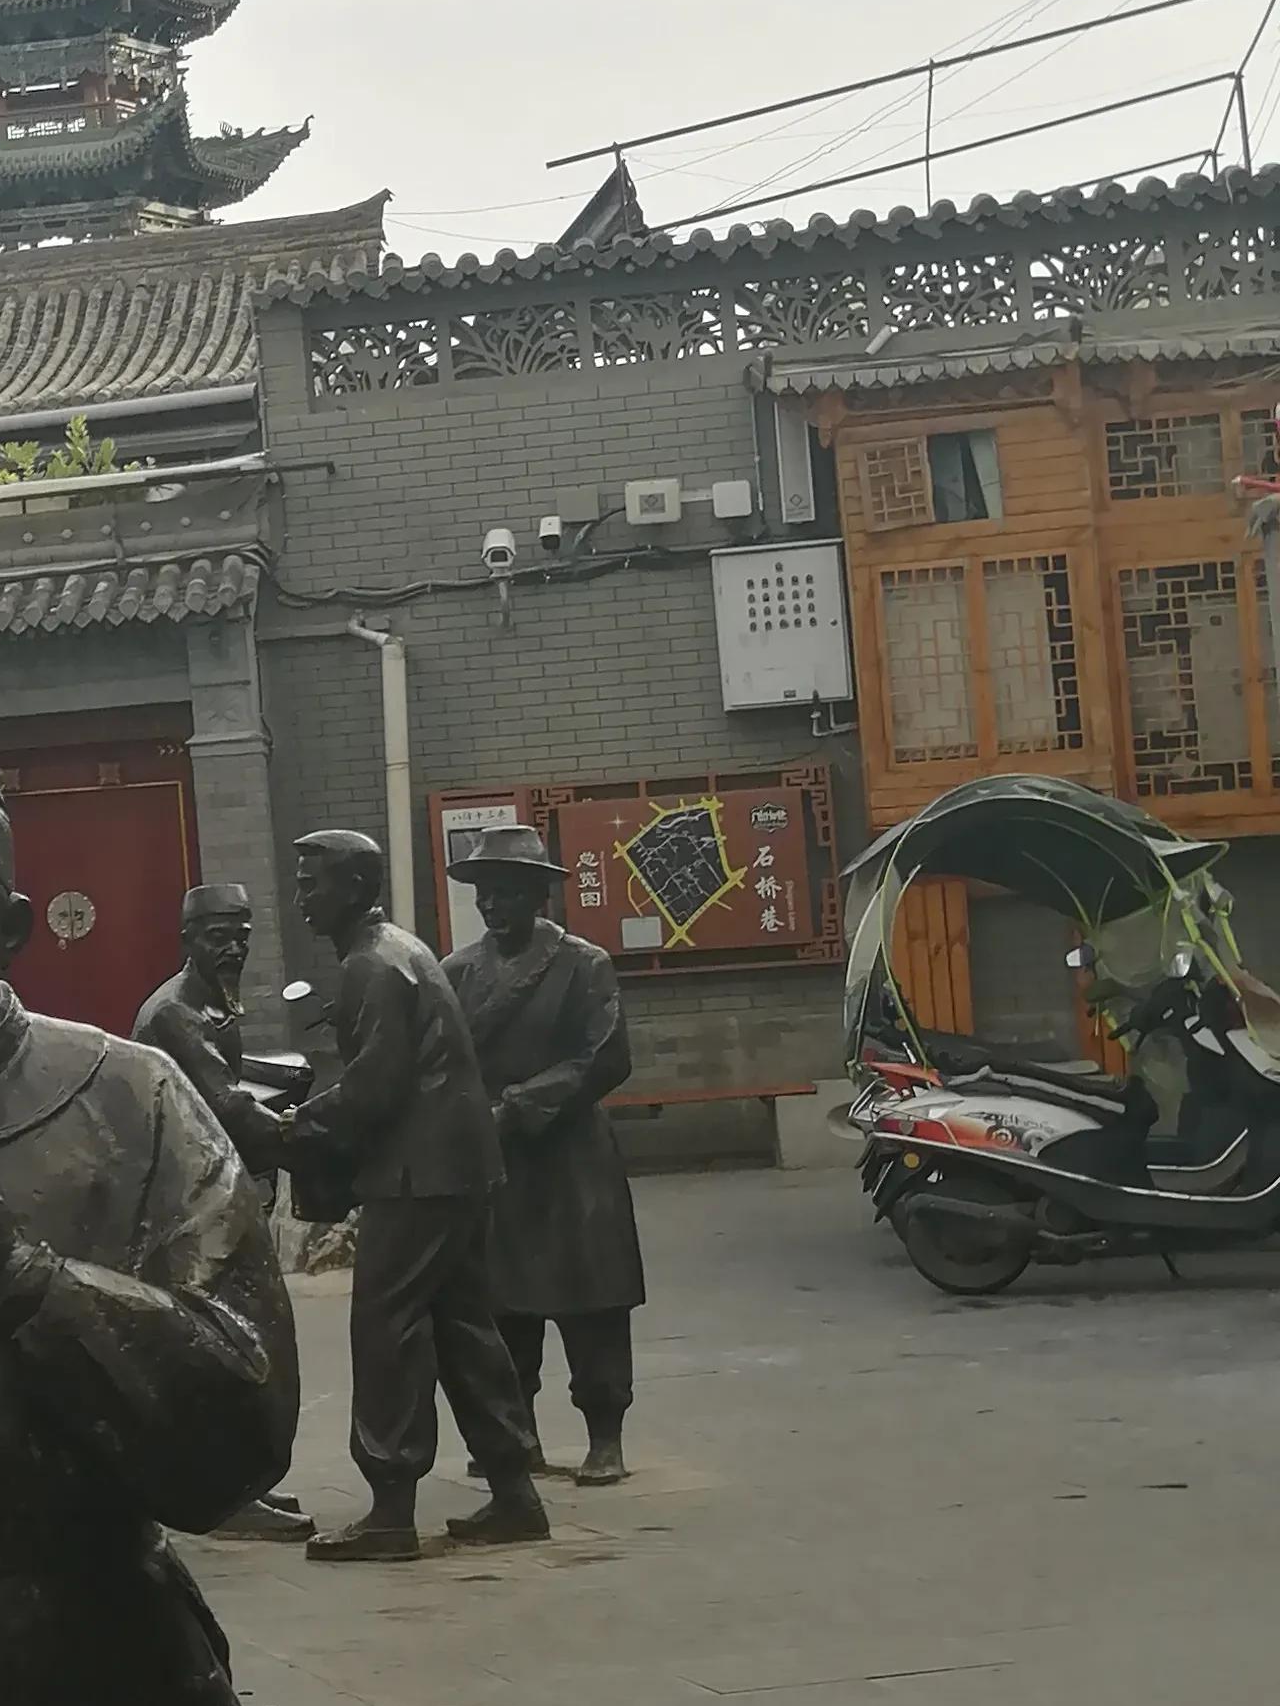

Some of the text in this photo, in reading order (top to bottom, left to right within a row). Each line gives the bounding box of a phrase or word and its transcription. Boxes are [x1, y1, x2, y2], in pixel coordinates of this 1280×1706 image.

[575, 851, 601, 908] 总览图
[752, 845, 786, 932] 石桥巷
